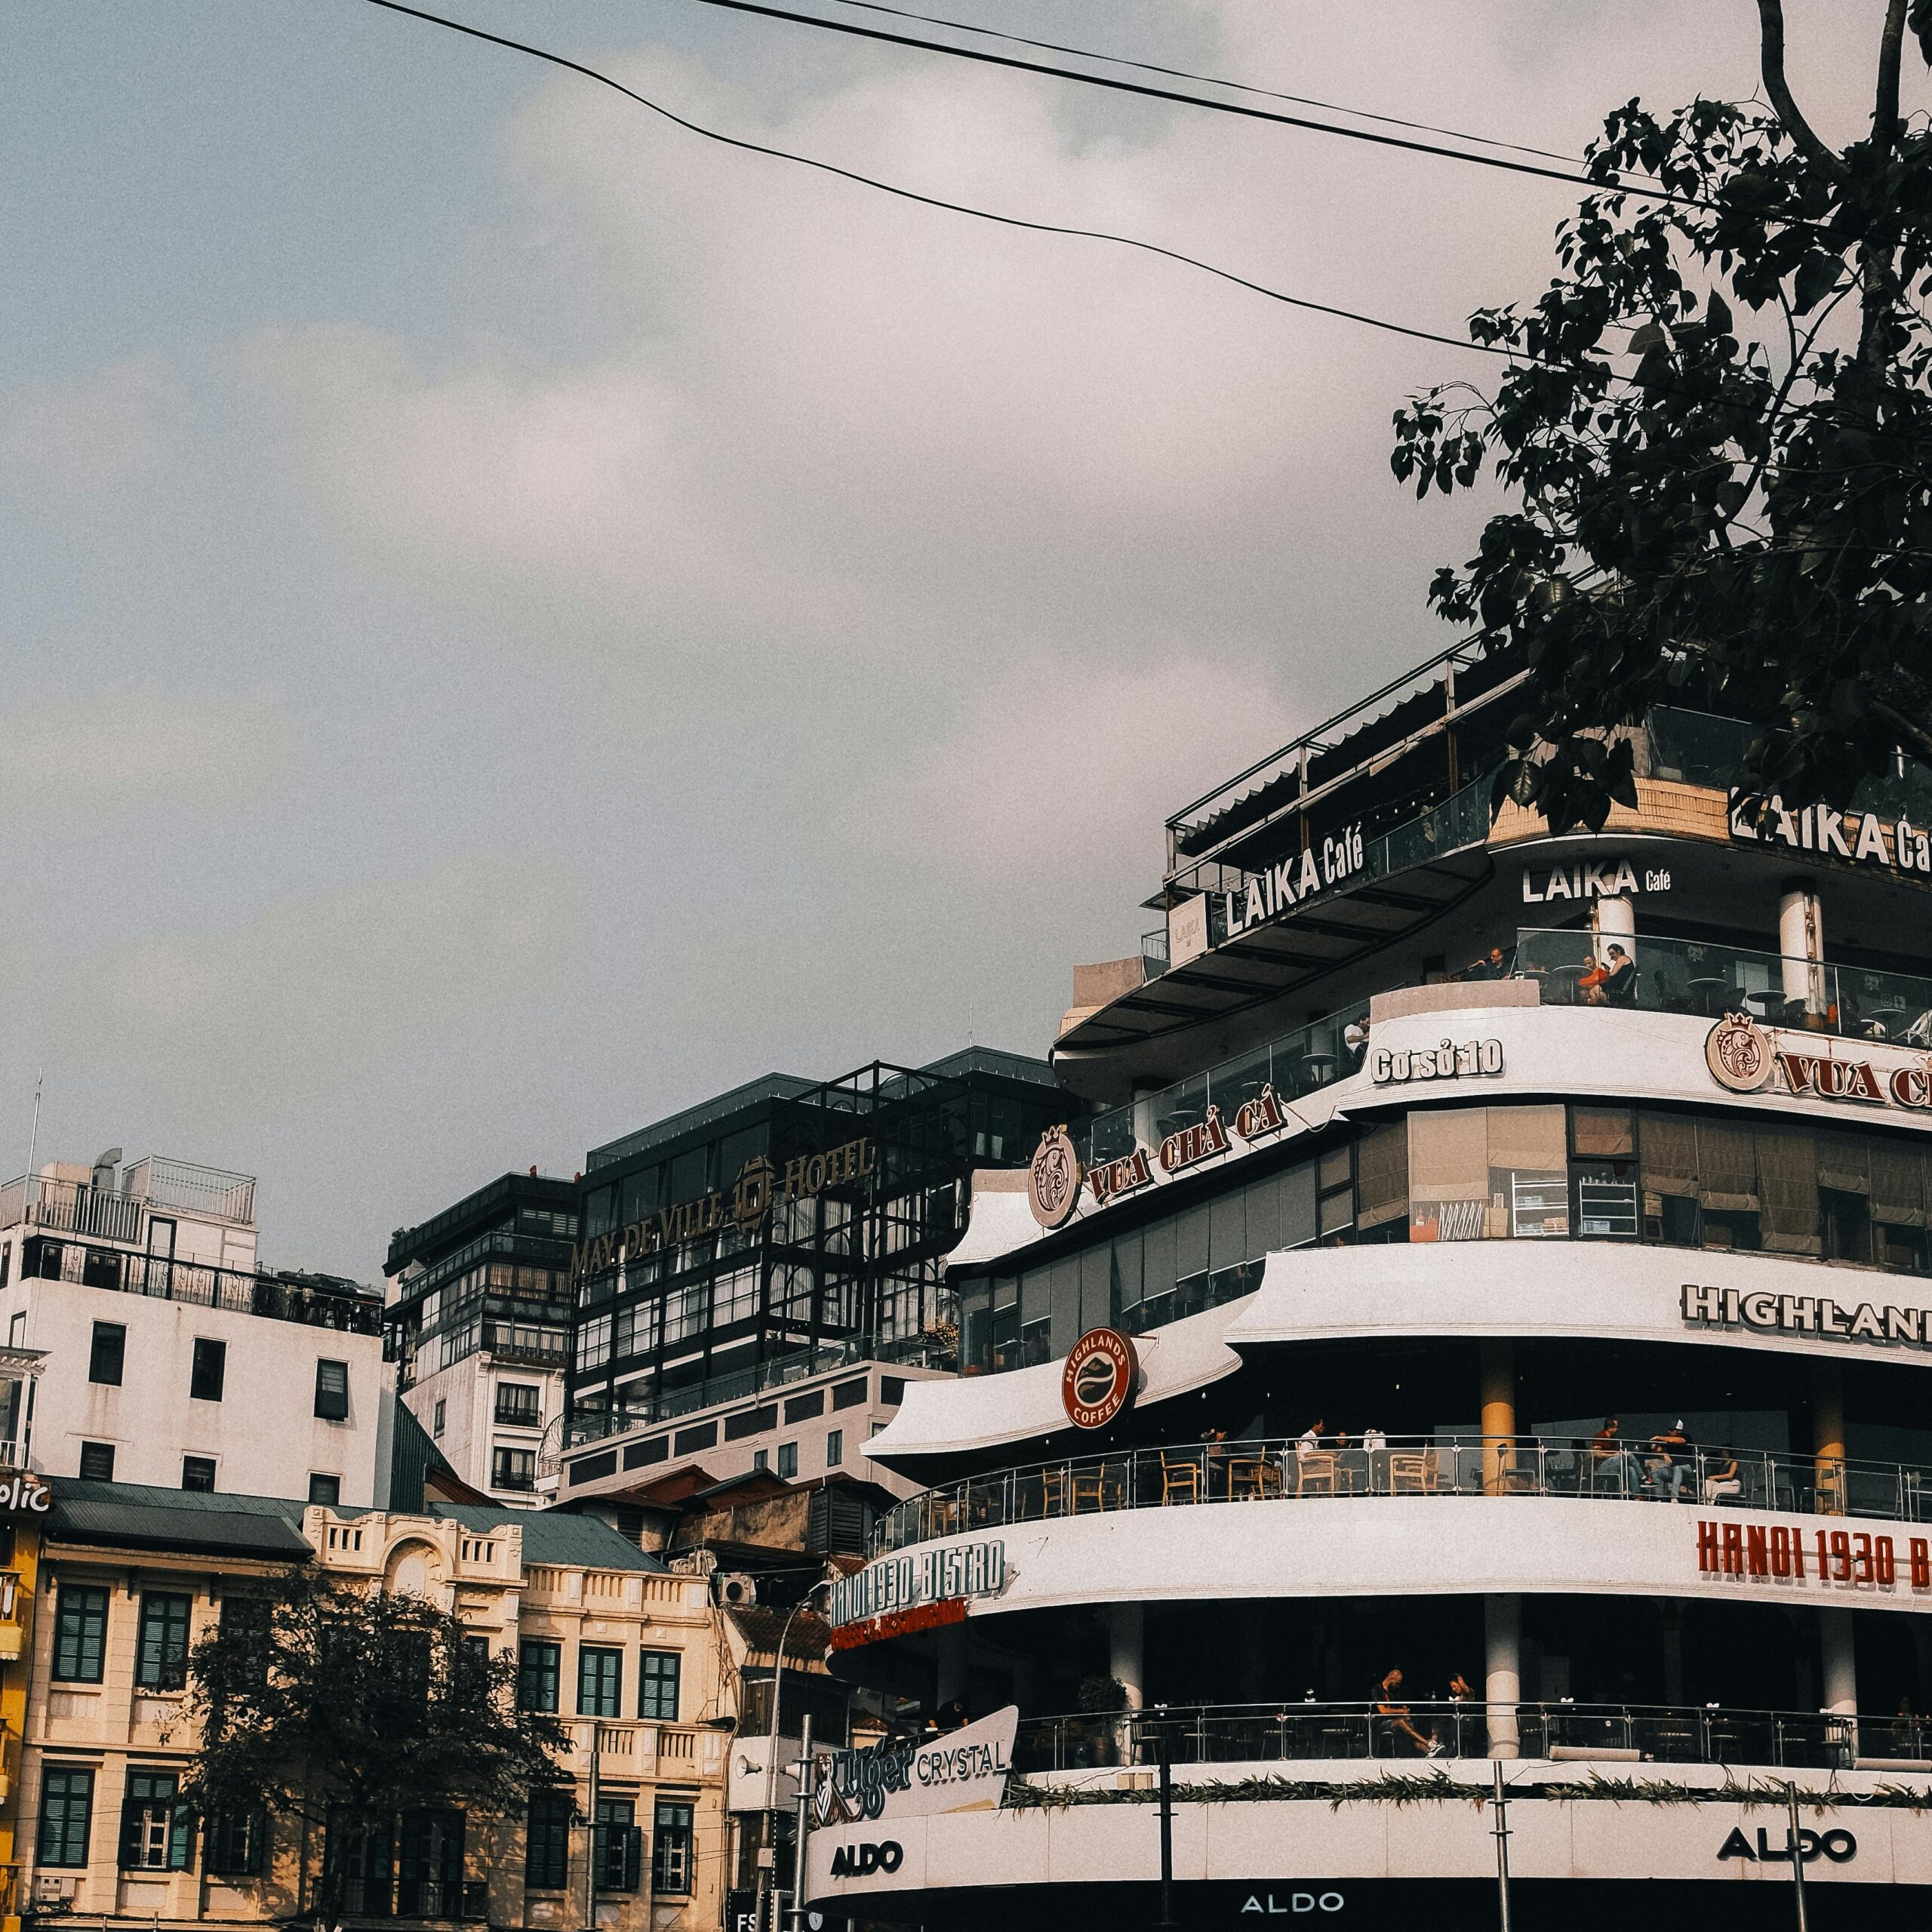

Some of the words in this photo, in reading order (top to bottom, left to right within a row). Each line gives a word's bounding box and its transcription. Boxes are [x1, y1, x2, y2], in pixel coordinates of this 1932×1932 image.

[1897, 820, 1932, 872] Ca
[1226, 847, 1321, 937] LAIKA
[1323, 823, 1363, 884] Café
[1522, 859, 1640, 903] LAIKA
[1645, 869, 1671, 892] Café
[1174, 917, 1201, 943] LAIKA
[1463, 1038, 1503, 1075] 10
[1775, 1051, 1887, 1103] VUA
[1889, 1068, 1932, 1109] C
[1088, 1148, 1156, 1204] VUA
[1158, 1104, 1232, 1174] CHẢ
[1235, 1082, 1289, 1143] CÁ
[570, 1231, 617, 1284] MAY
[623, 1217, 654, 1262] DE
[784, 1137, 875, 1202] HOTEL
[1066, 1334, 1126, 1383] HIGHLANDS
[1073, 1393, 1121, 1423] COFFEE
[1697, 1521, 1806, 1579] HANOI
[1815, 1530, 1895, 1586] 1930
[1909, 1537, 1932, 1588] B
[829, 1570, 869, 1628] HANOI
[870, 1556, 914, 1614] 1930
[920, 1540, 1005, 1601] BISTRO
[831, 1737, 916, 1820] Tiger
[917, 1740, 1007, 1784] CRYSTAL
[829, 1840, 904, 1878] ALDO
[1717, 1826, 1857, 1863] ALDO
[1240, 1892, 1344, 1914] ALDO
